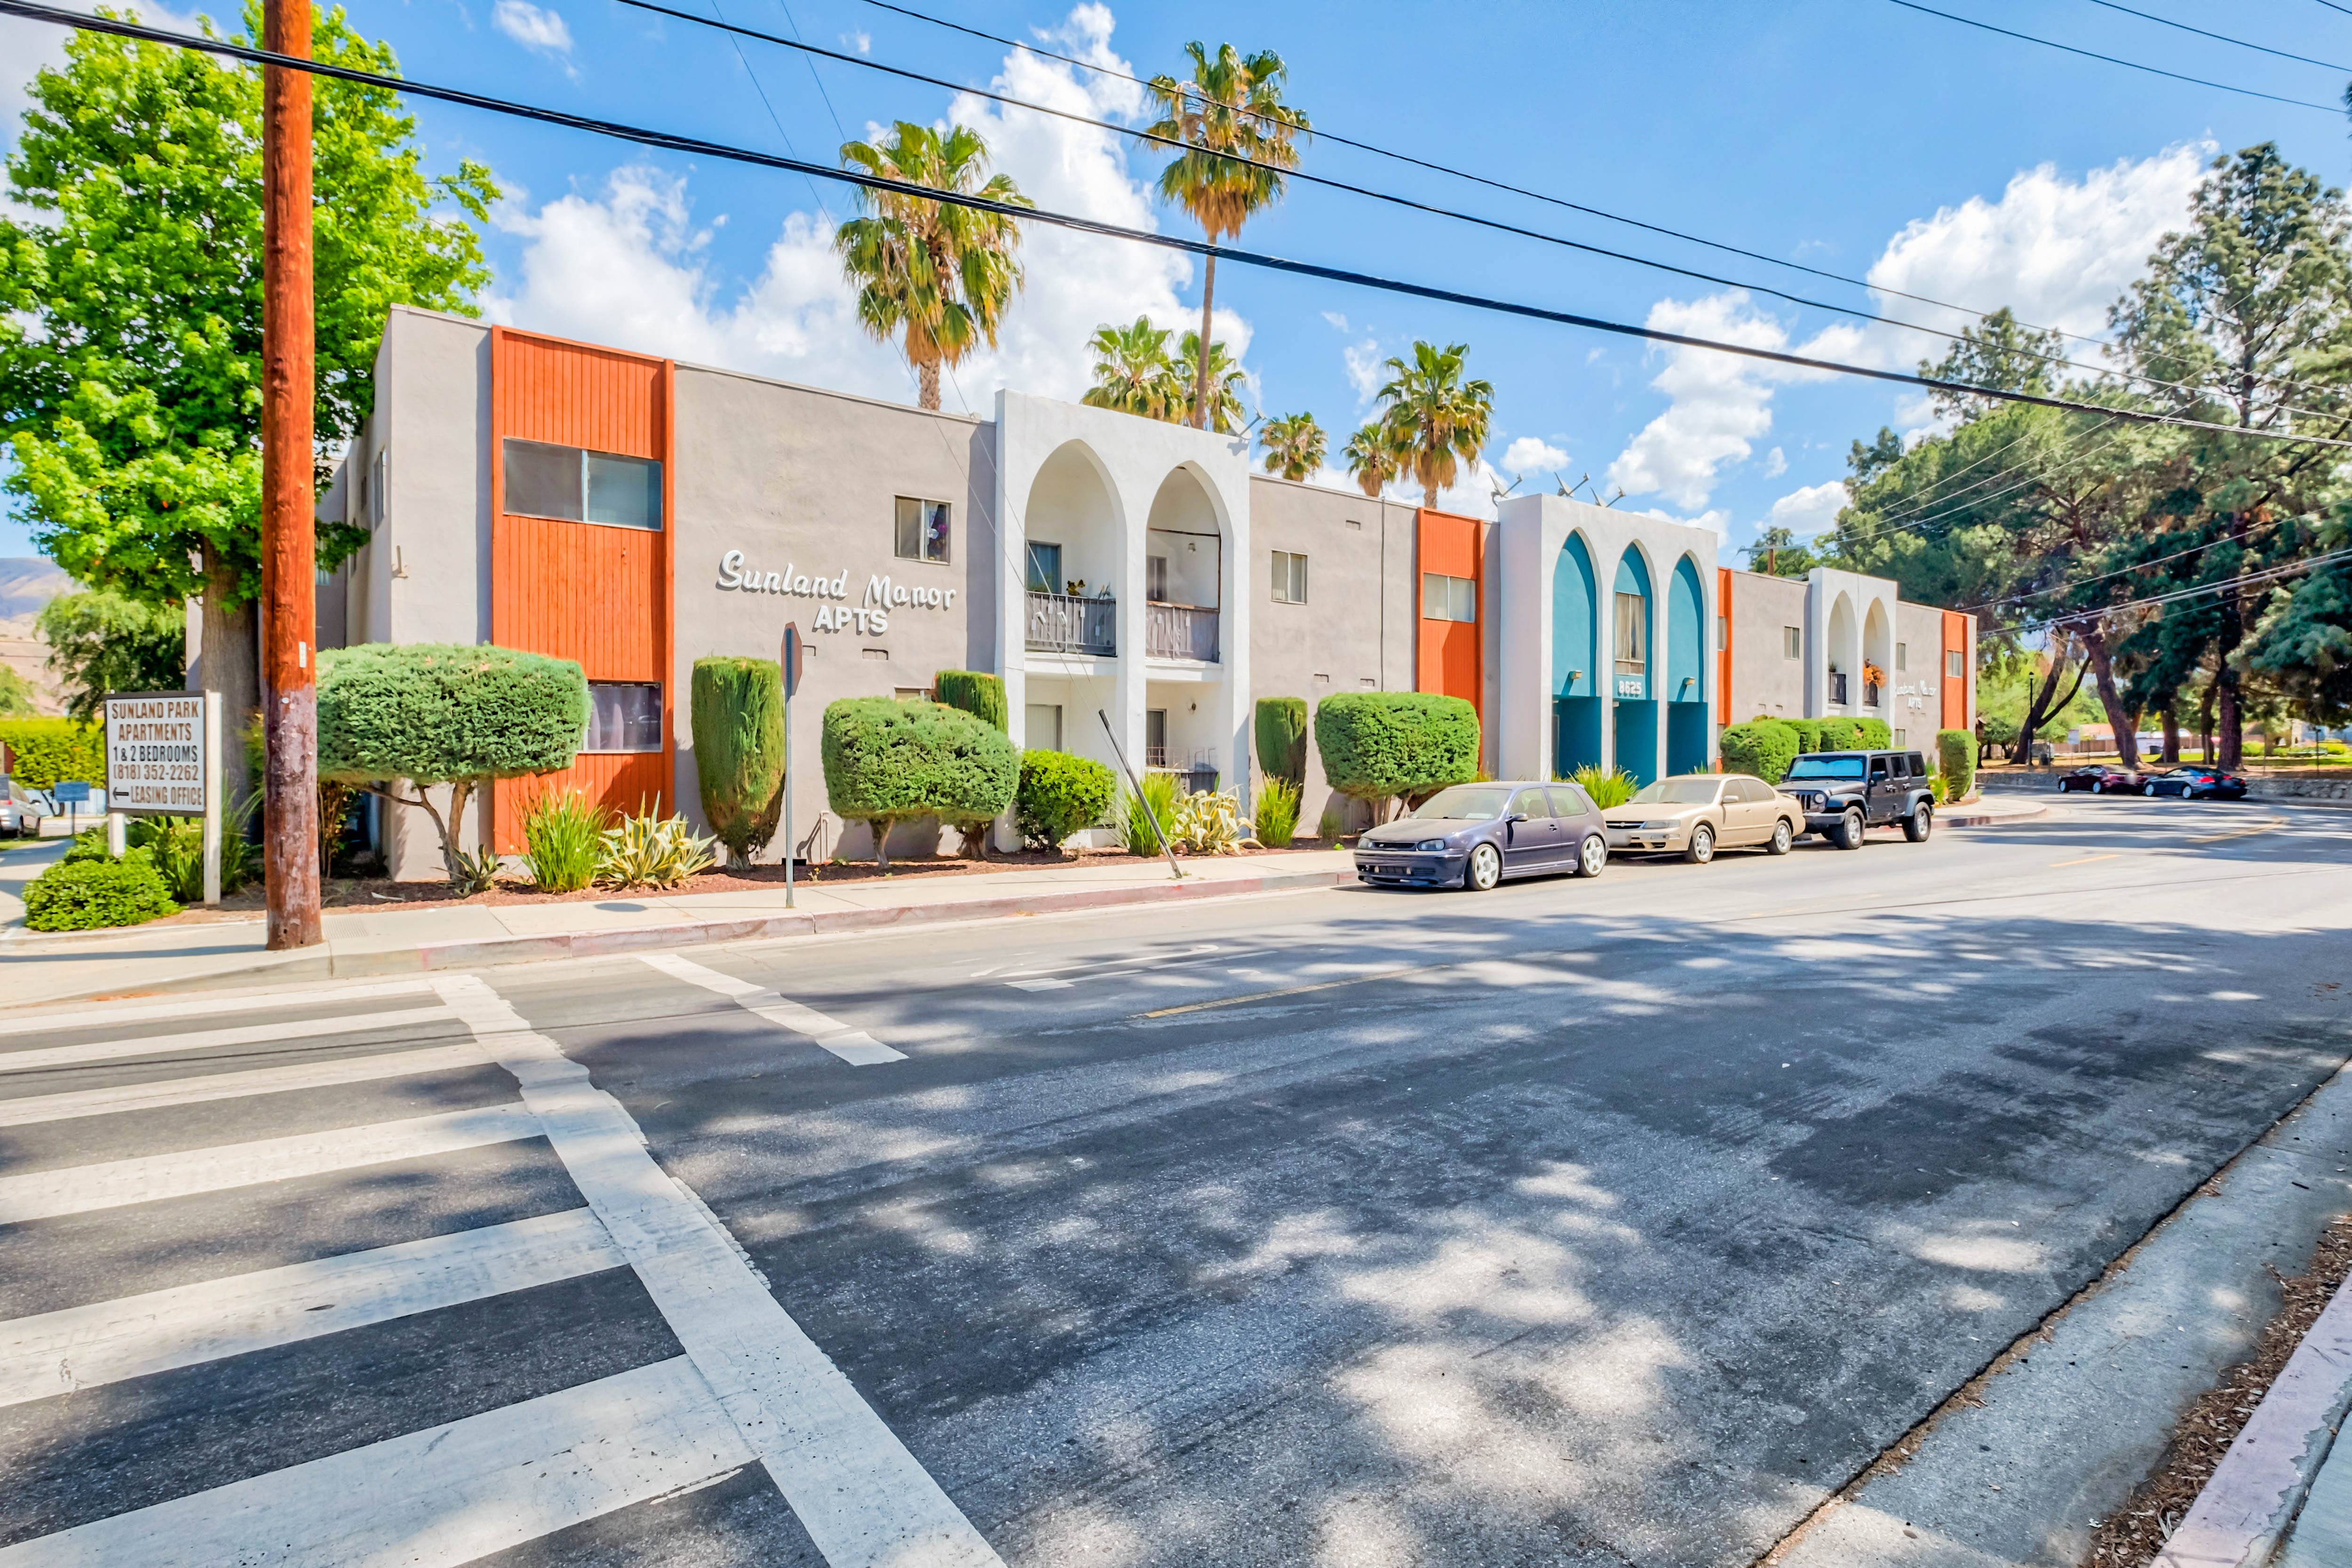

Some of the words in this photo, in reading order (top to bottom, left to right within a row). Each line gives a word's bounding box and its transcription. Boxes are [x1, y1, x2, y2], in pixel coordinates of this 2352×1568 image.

[717, 549, 848, 598] Sunland
[864, 574, 957, 608] Manor
[814, 605, 888, 634] APTS
[1618, 680, 1642, 695] 8625
[112, 702, 163, 719] SUNLAND
[168, 701, 199, 718] PARK
[119, 723, 191, 741] APARTMENTS
[113, 746, 118, 761] 1
[121, 748, 127, 761] &
[130, 746, 136, 761] 2
[140, 746, 198, 762] BEDROOMS
[113, 764, 140, 780] (818)
[143, 764, 199, 780] 352-2262
[131, 786, 167, 804] LEASING
[171, 787, 202, 805] OFFICE
